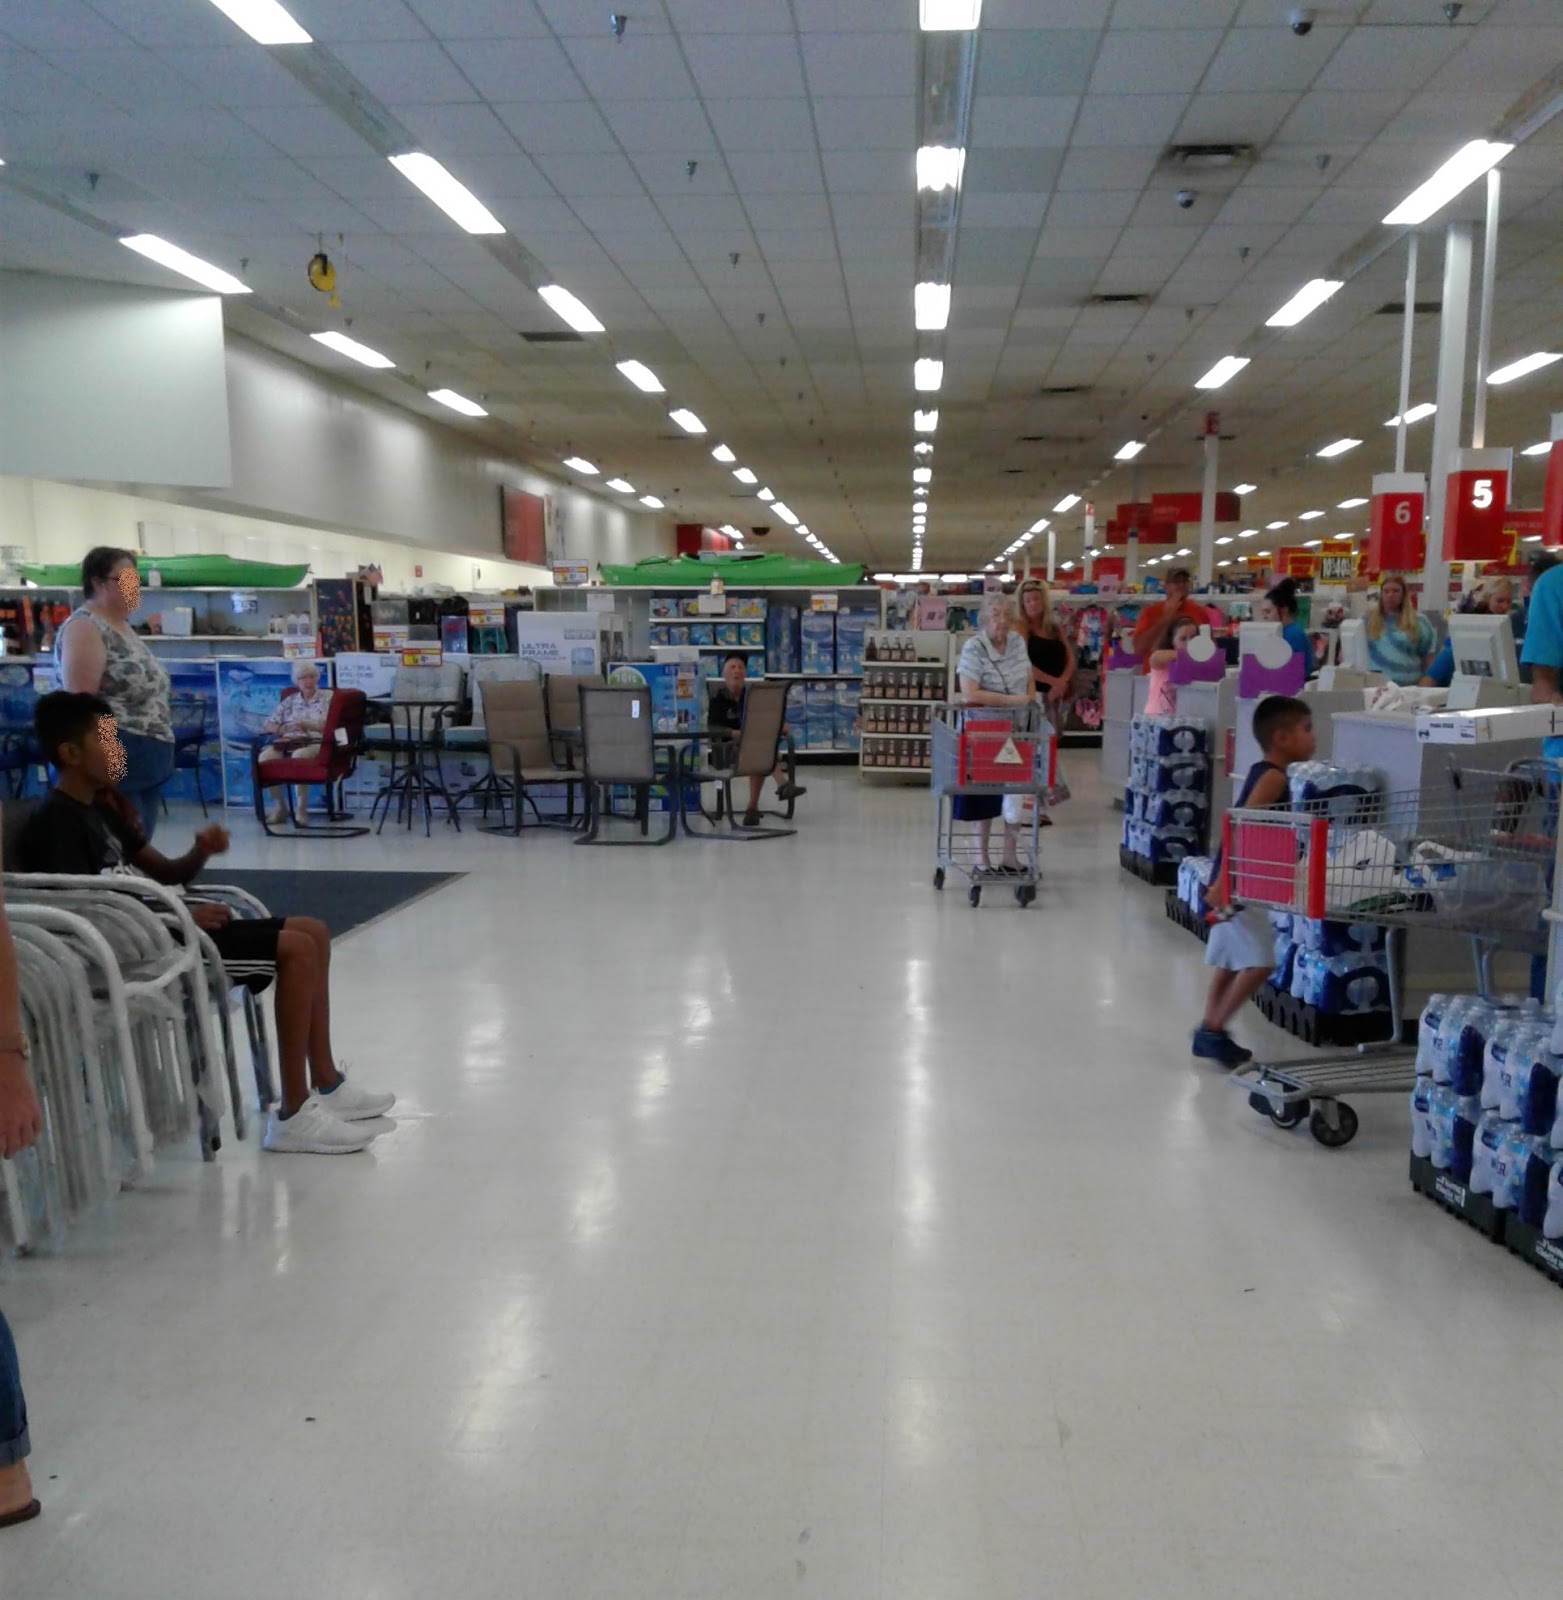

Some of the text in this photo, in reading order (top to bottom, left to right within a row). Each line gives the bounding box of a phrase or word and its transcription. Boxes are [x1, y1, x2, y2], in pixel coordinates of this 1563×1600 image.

[1472, 479, 1493, 508] 5
[1394, 501, 1411, 524] 6
[521, 649, 560, 657] FRAME
